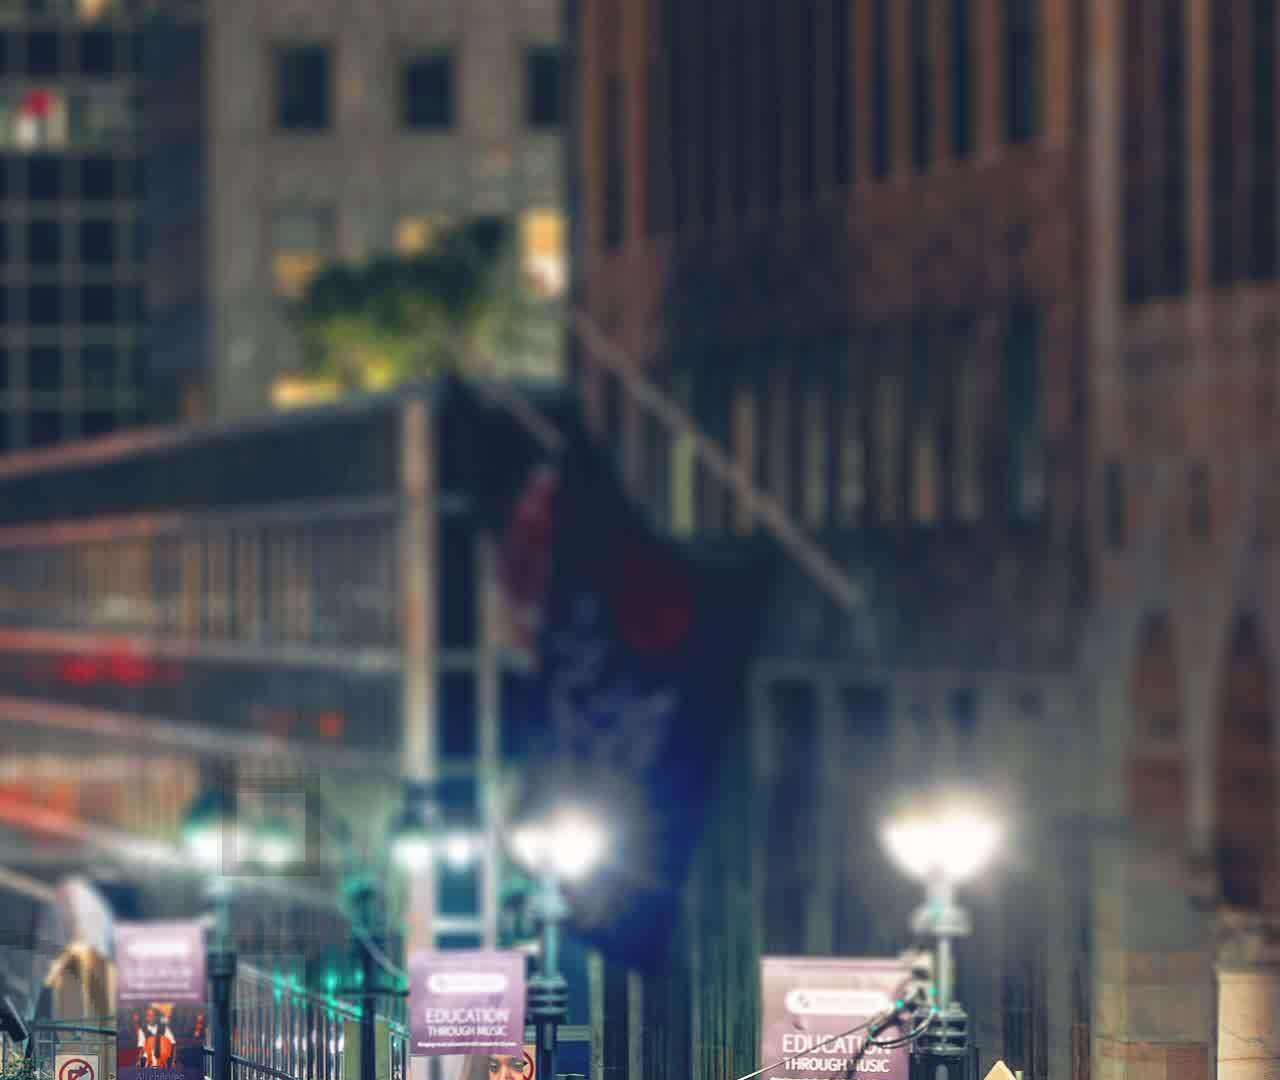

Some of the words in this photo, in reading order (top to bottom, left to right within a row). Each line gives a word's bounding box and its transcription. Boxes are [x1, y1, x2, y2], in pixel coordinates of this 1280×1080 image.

[425, 1008, 510, 1024] EDUCATION
[427, 1025, 474, 1037] THROUGH
[477, 1025, 508, 1037] MUSIC
[783, 1056, 847, 1072] THROUGH
